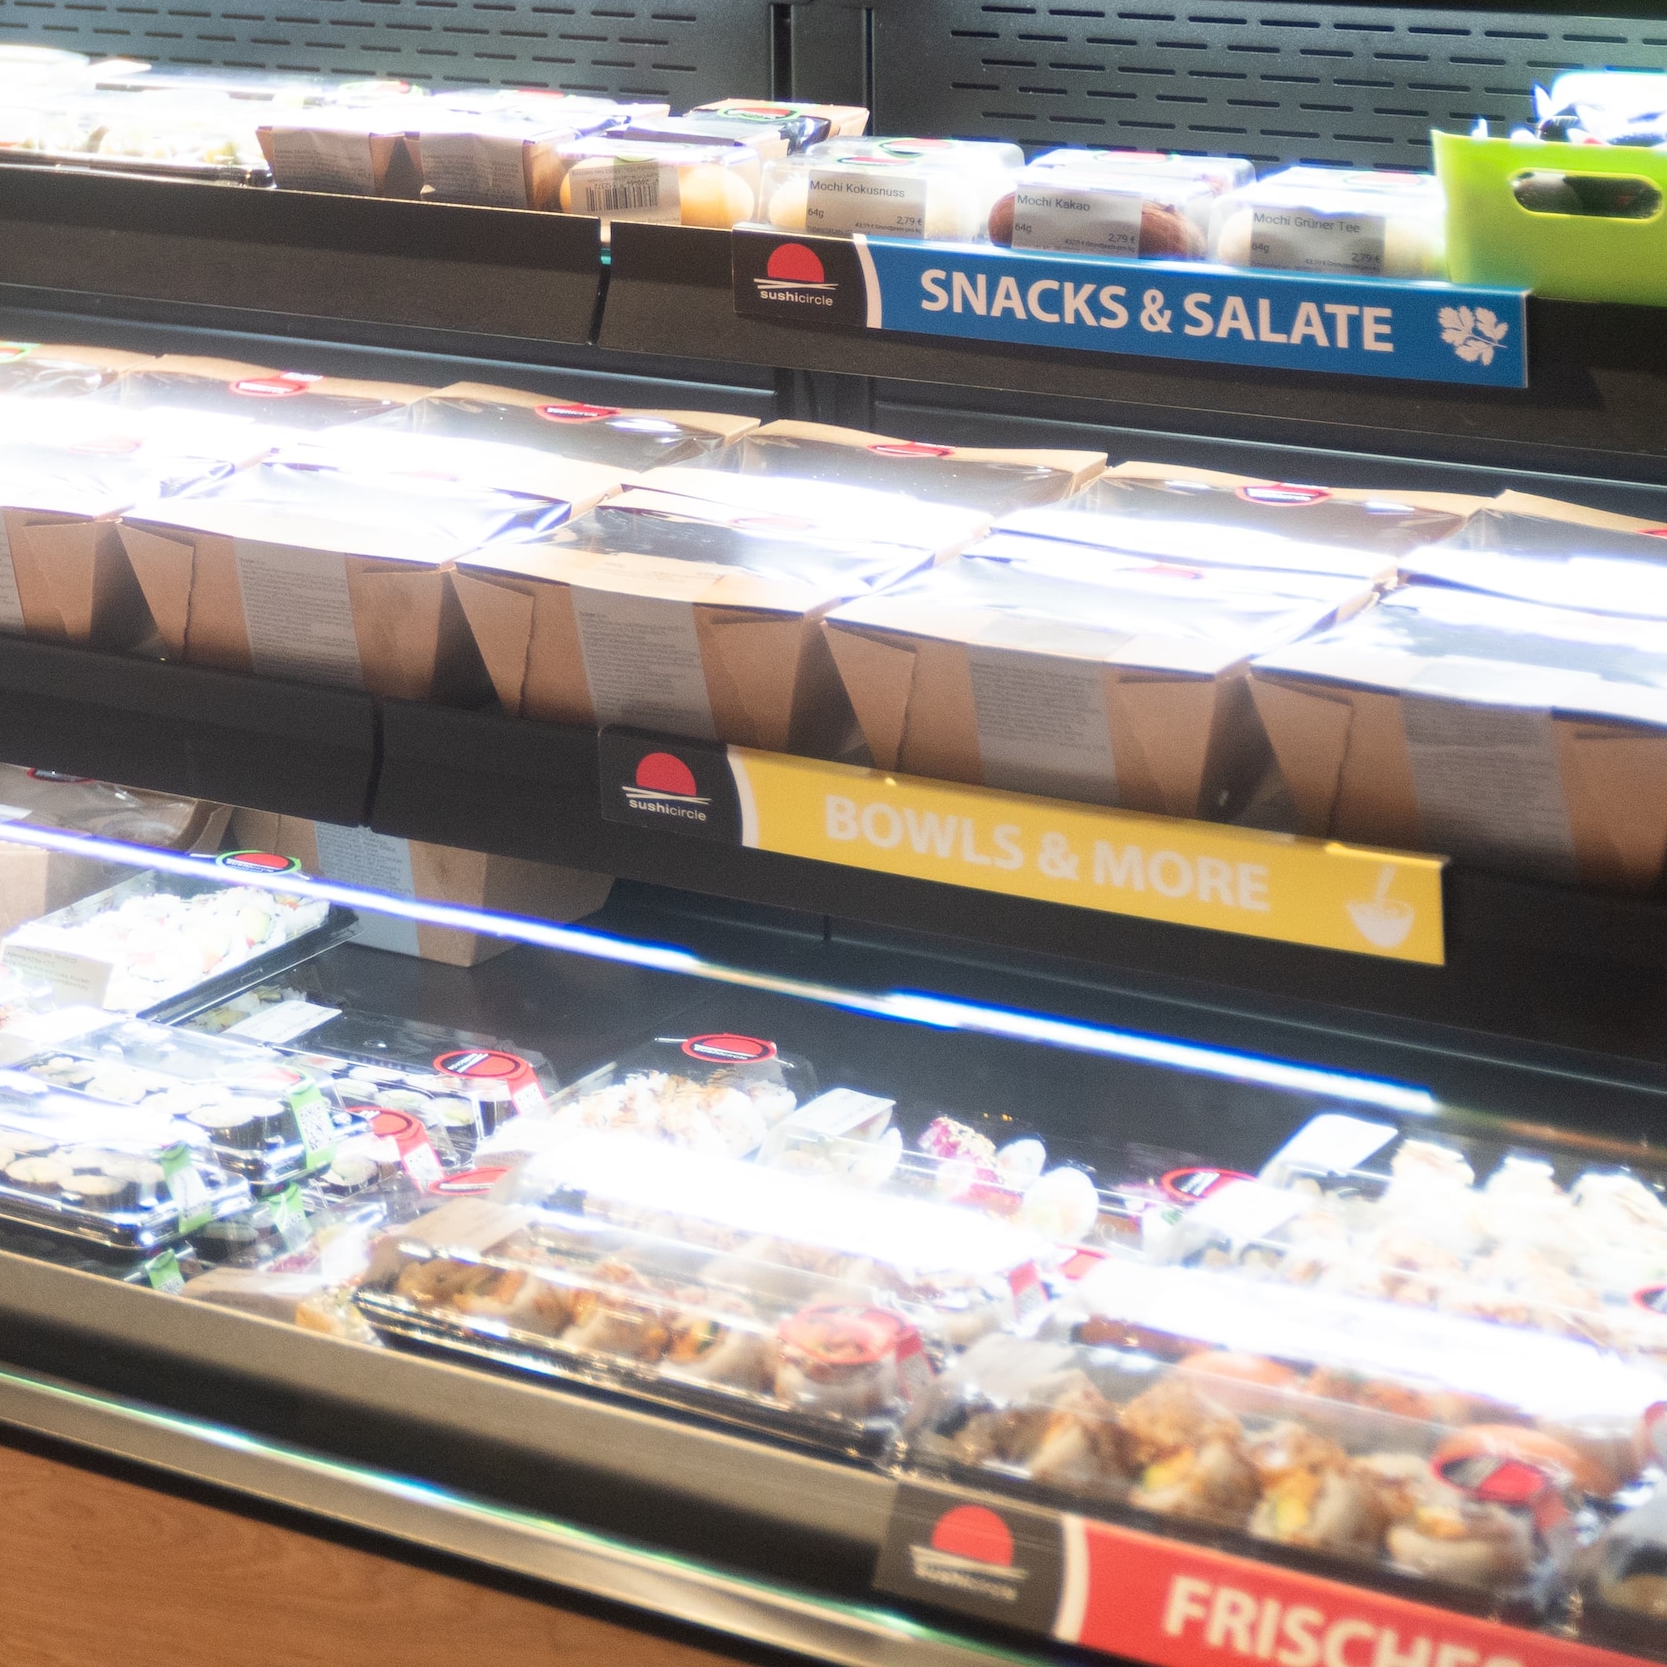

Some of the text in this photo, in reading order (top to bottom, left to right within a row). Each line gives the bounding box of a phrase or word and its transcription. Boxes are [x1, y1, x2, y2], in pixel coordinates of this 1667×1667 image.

[810, 180, 905, 197] Mochi Kokusnuss
[1017, 195, 1090, 211] Mochi Kakao
[807, 208, 923, 226] 64g 2,79 €
[1254, 212, 1360, 233] Mochi Grüner Tee
[1014, 223, 1136, 244] 64g 2,79 €
[1252, 242, 1270, 254] 64g
[760, 287, 834, 308] sushicircle
[919, 268, 1395, 353] SNACKS & SALATE
[628, 795, 708, 823] sushicircle
[825, 793, 1271, 913] BOWLS & MORE
